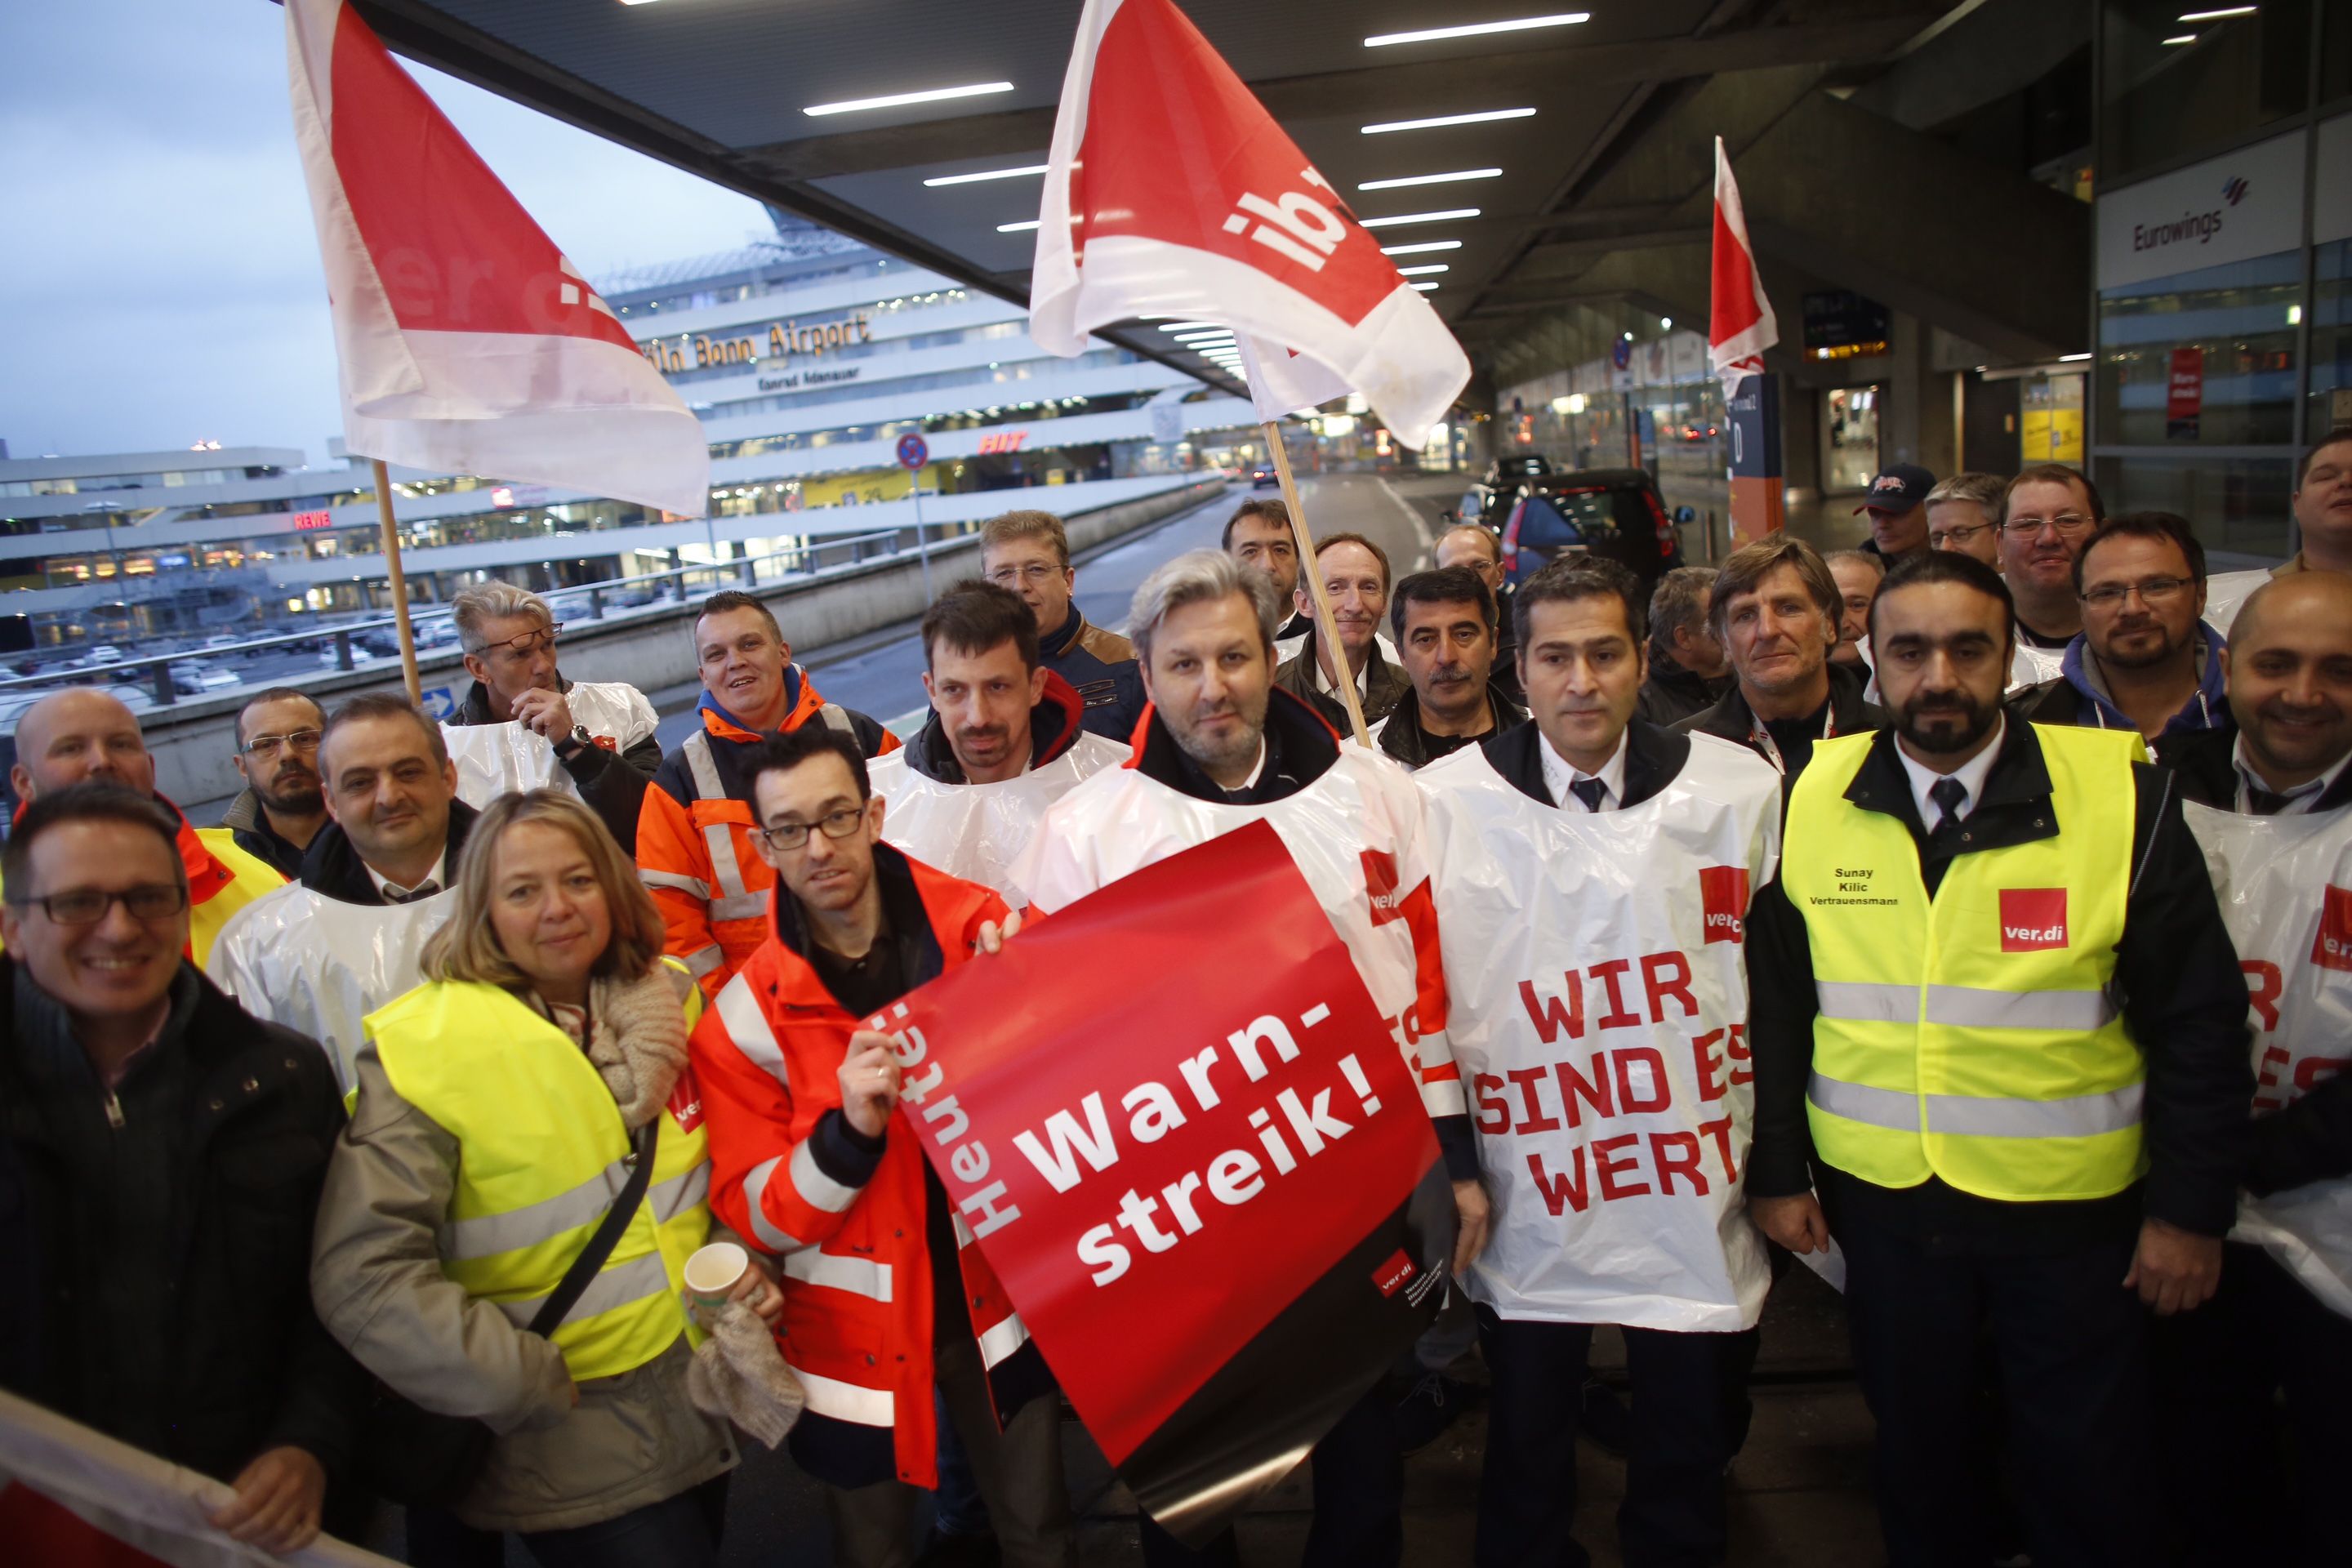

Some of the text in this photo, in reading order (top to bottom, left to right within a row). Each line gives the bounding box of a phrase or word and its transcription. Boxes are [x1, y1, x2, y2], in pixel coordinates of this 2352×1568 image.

[2134, 210, 2222, 252] Eurowings
[641, 313, 873, 374] öln Bonn Airport
[757, 376, 799, 393] Konrad
[978, 430, 1029, 455] HIT
[1734, 421, 1743, 463] D
[293, 510, 332, 530] REWE
[1834, 868, 1873, 880] Sunay
[1838, 883, 1869, 893] Kilic
[1810, 897, 1899, 906] Vertrauensmann
[2004, 925, 2064, 942] ver.di
[1518, 951, 1700, 1045] WIR
[1012, 1002, 1330, 1194] Warn-
[1473, 1046, 1673, 1136] SIND
[1076, 1053, 1382, 1288] streik!
[1526, 1112, 1739, 1217] WERT
